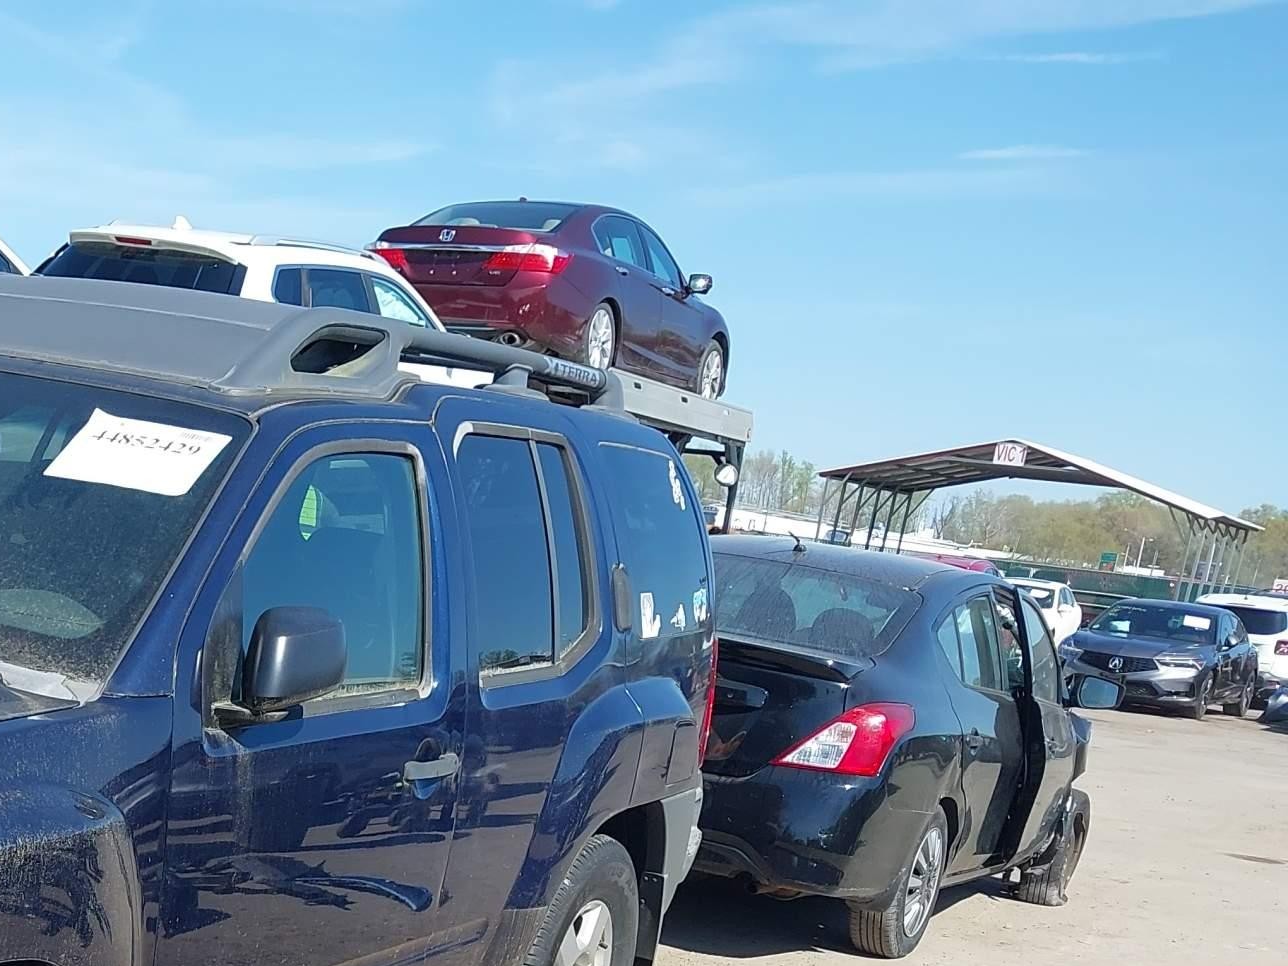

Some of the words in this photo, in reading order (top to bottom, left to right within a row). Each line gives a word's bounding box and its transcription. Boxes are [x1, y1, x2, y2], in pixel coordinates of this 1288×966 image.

[92, 429, 201, 455] 44852429
[997, 444, 1017, 462] VIC
[1019, 446, 1027, 463] 1
